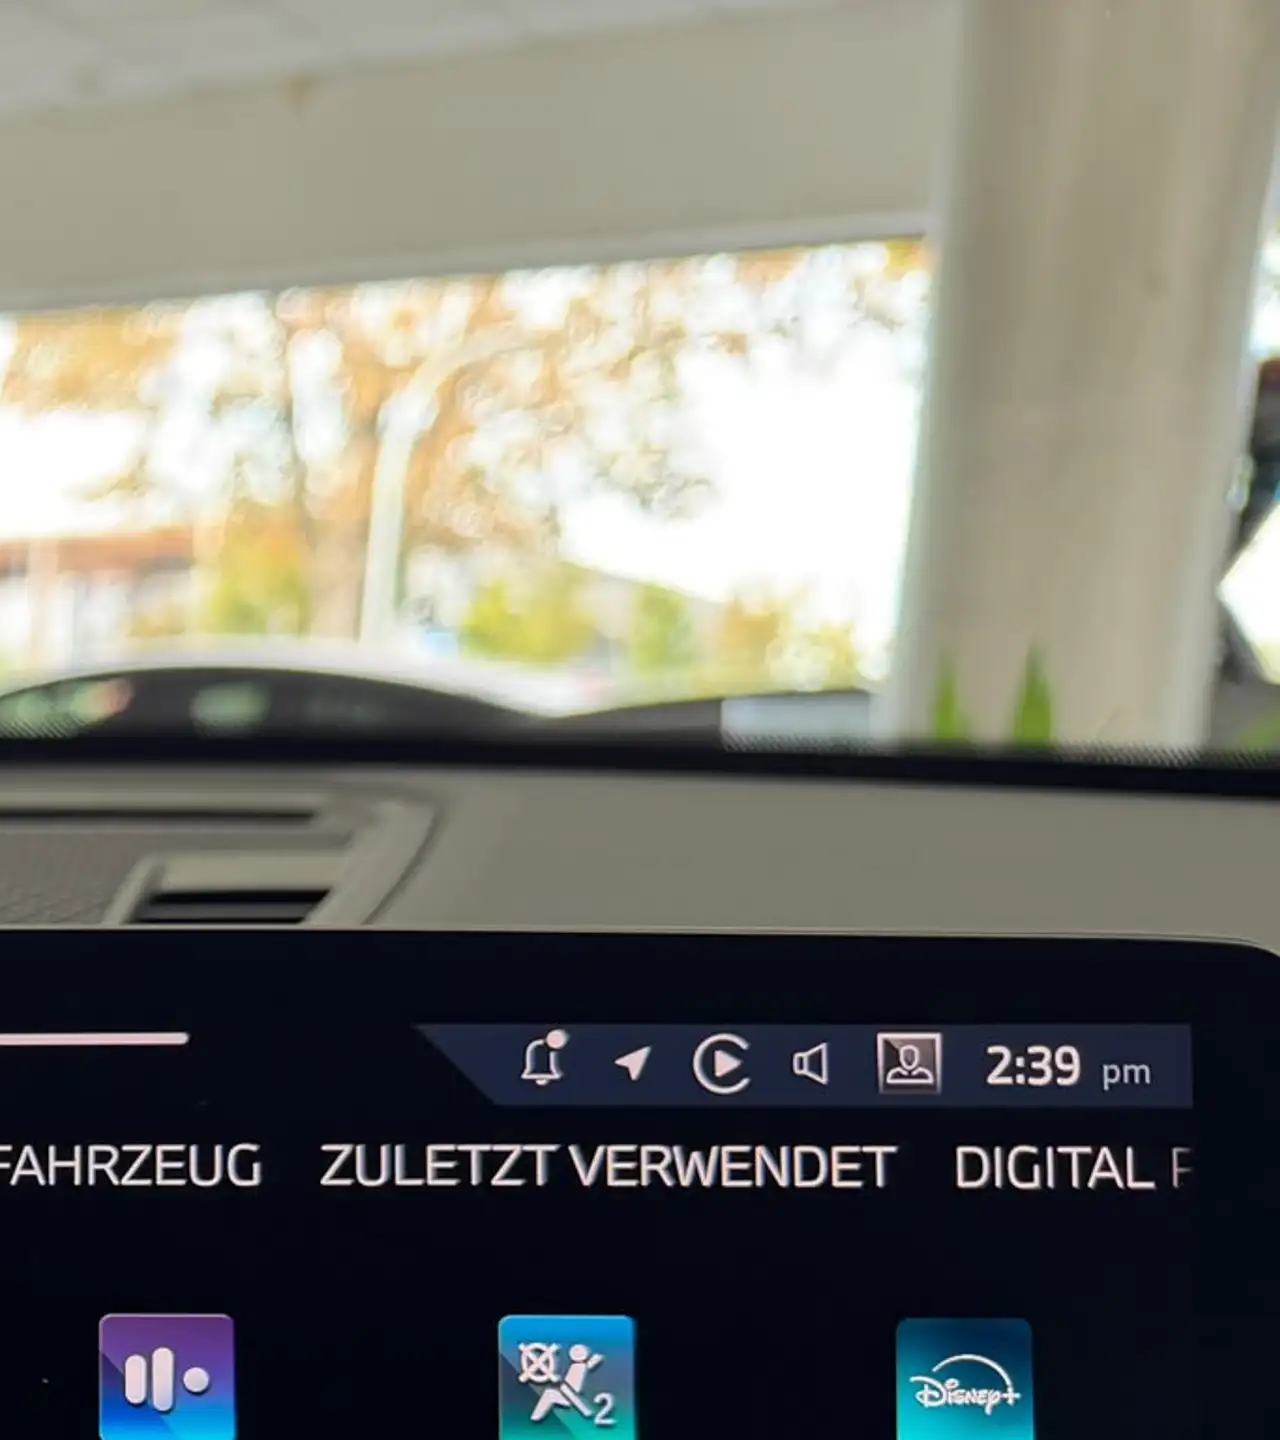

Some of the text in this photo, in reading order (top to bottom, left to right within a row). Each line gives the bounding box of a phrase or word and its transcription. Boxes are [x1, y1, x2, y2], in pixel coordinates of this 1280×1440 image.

[986, 1045, 1151, 1091] 2:39 pm
[320, 1143, 898, 1188] ZULETZT VERWENDET
[956, 1145, 1156, 1190] DIGITAL
[909, 1376, 1022, 1415] Disney+
